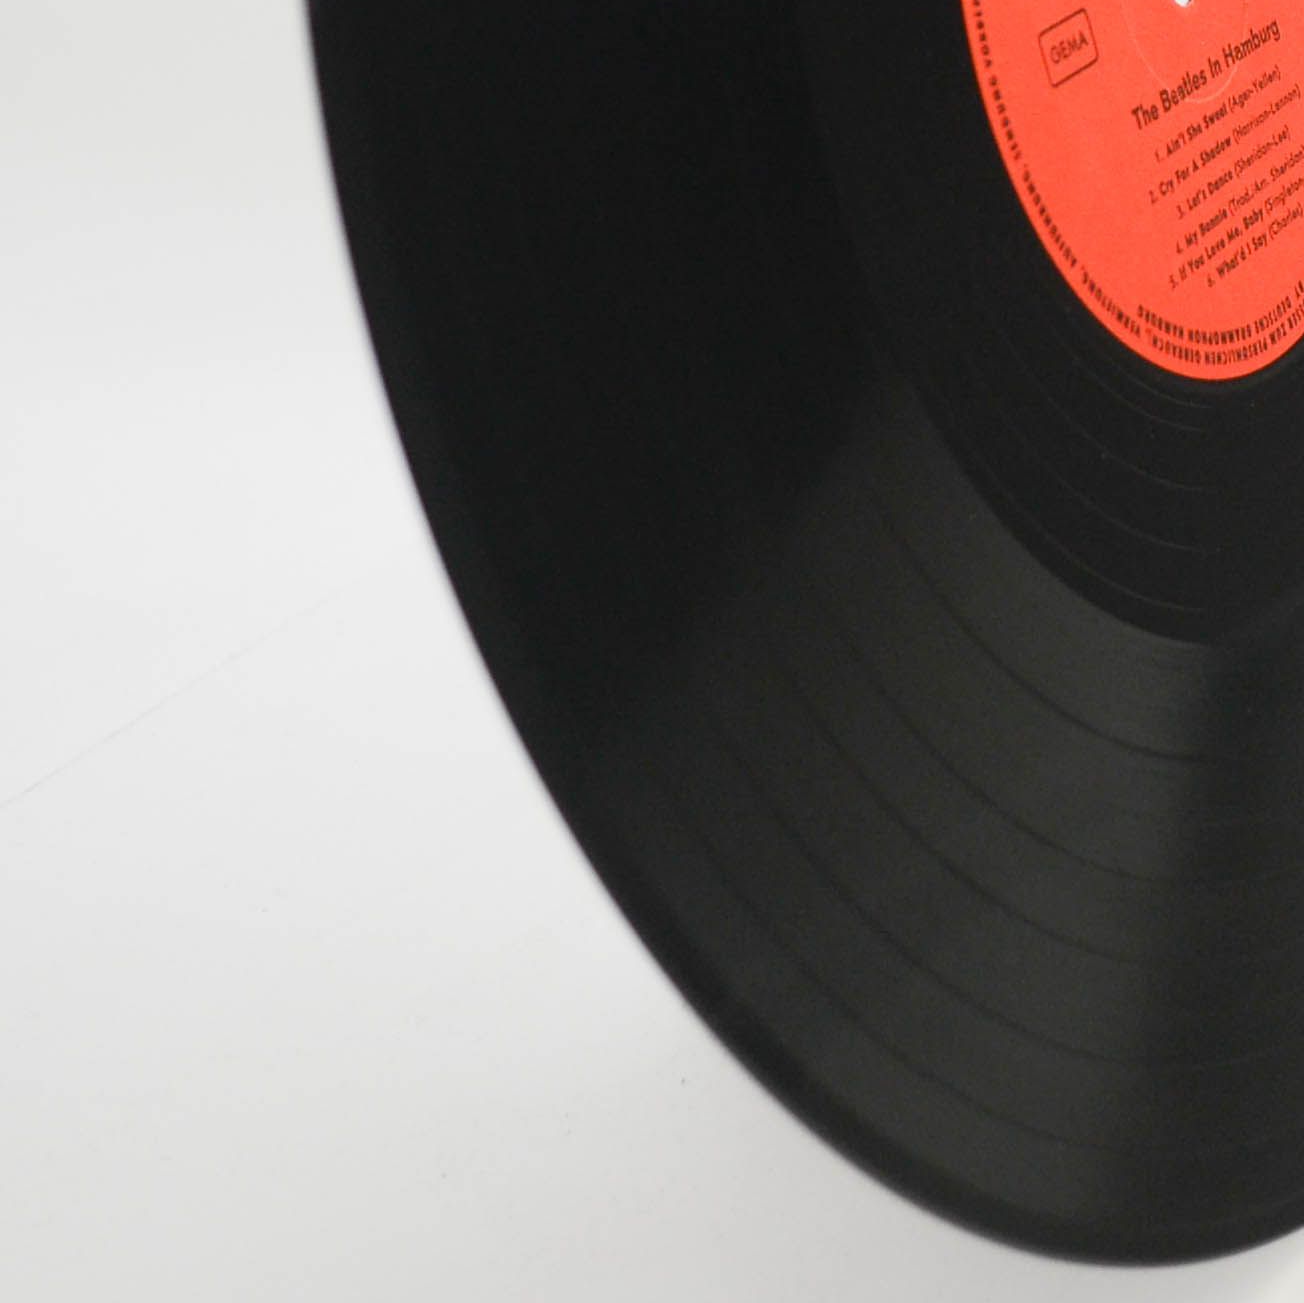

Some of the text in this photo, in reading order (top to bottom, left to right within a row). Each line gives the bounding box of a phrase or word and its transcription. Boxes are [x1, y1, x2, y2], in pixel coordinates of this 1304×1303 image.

[1051, 32, 1089, 64] GEMA
[1131, 19, 1280, 130] The Beatles In Hamburg
[1186, 123, 1203, 141] She
[1202, 102, 1228, 130] Sweet
[1228, 64, 1281, 113] (Ager-Yellen)
[1159, 179, 1174, 196] Cry
[1174, 167, 1190, 184] For
[1192, 159, 1200, 173] A
[1199, 136, 1231, 167] Shadow
[1186, 189, 1207, 211] Let's
[1207, 170, 1233, 196] Dance
[1178, 264, 1187, 281] If
[1187, 254, 1205, 272] You
[1205, 238, 1226, 260] Love
[1226, 227, 1243, 243] Me,
[1242, 208, 1263, 230] Baby
[1184, 230, 1198, 248] My
[1198, 208, 1228, 237] Bonnie
[1216, 246, 1247, 278] What'd
[1252, 232, 1267, 251] Say
[1269, 202, 1303, 240] (Charles)
[1294, 280, 1304, 299] BY
[1137, 304, 1184, 338] HAMBURG
[1188, 324, 1251, 345] GRAMMOPHON
[1254, 295, 1291, 334] DEUTSCHE
[1269, 323, 1287, 345] ZUM
